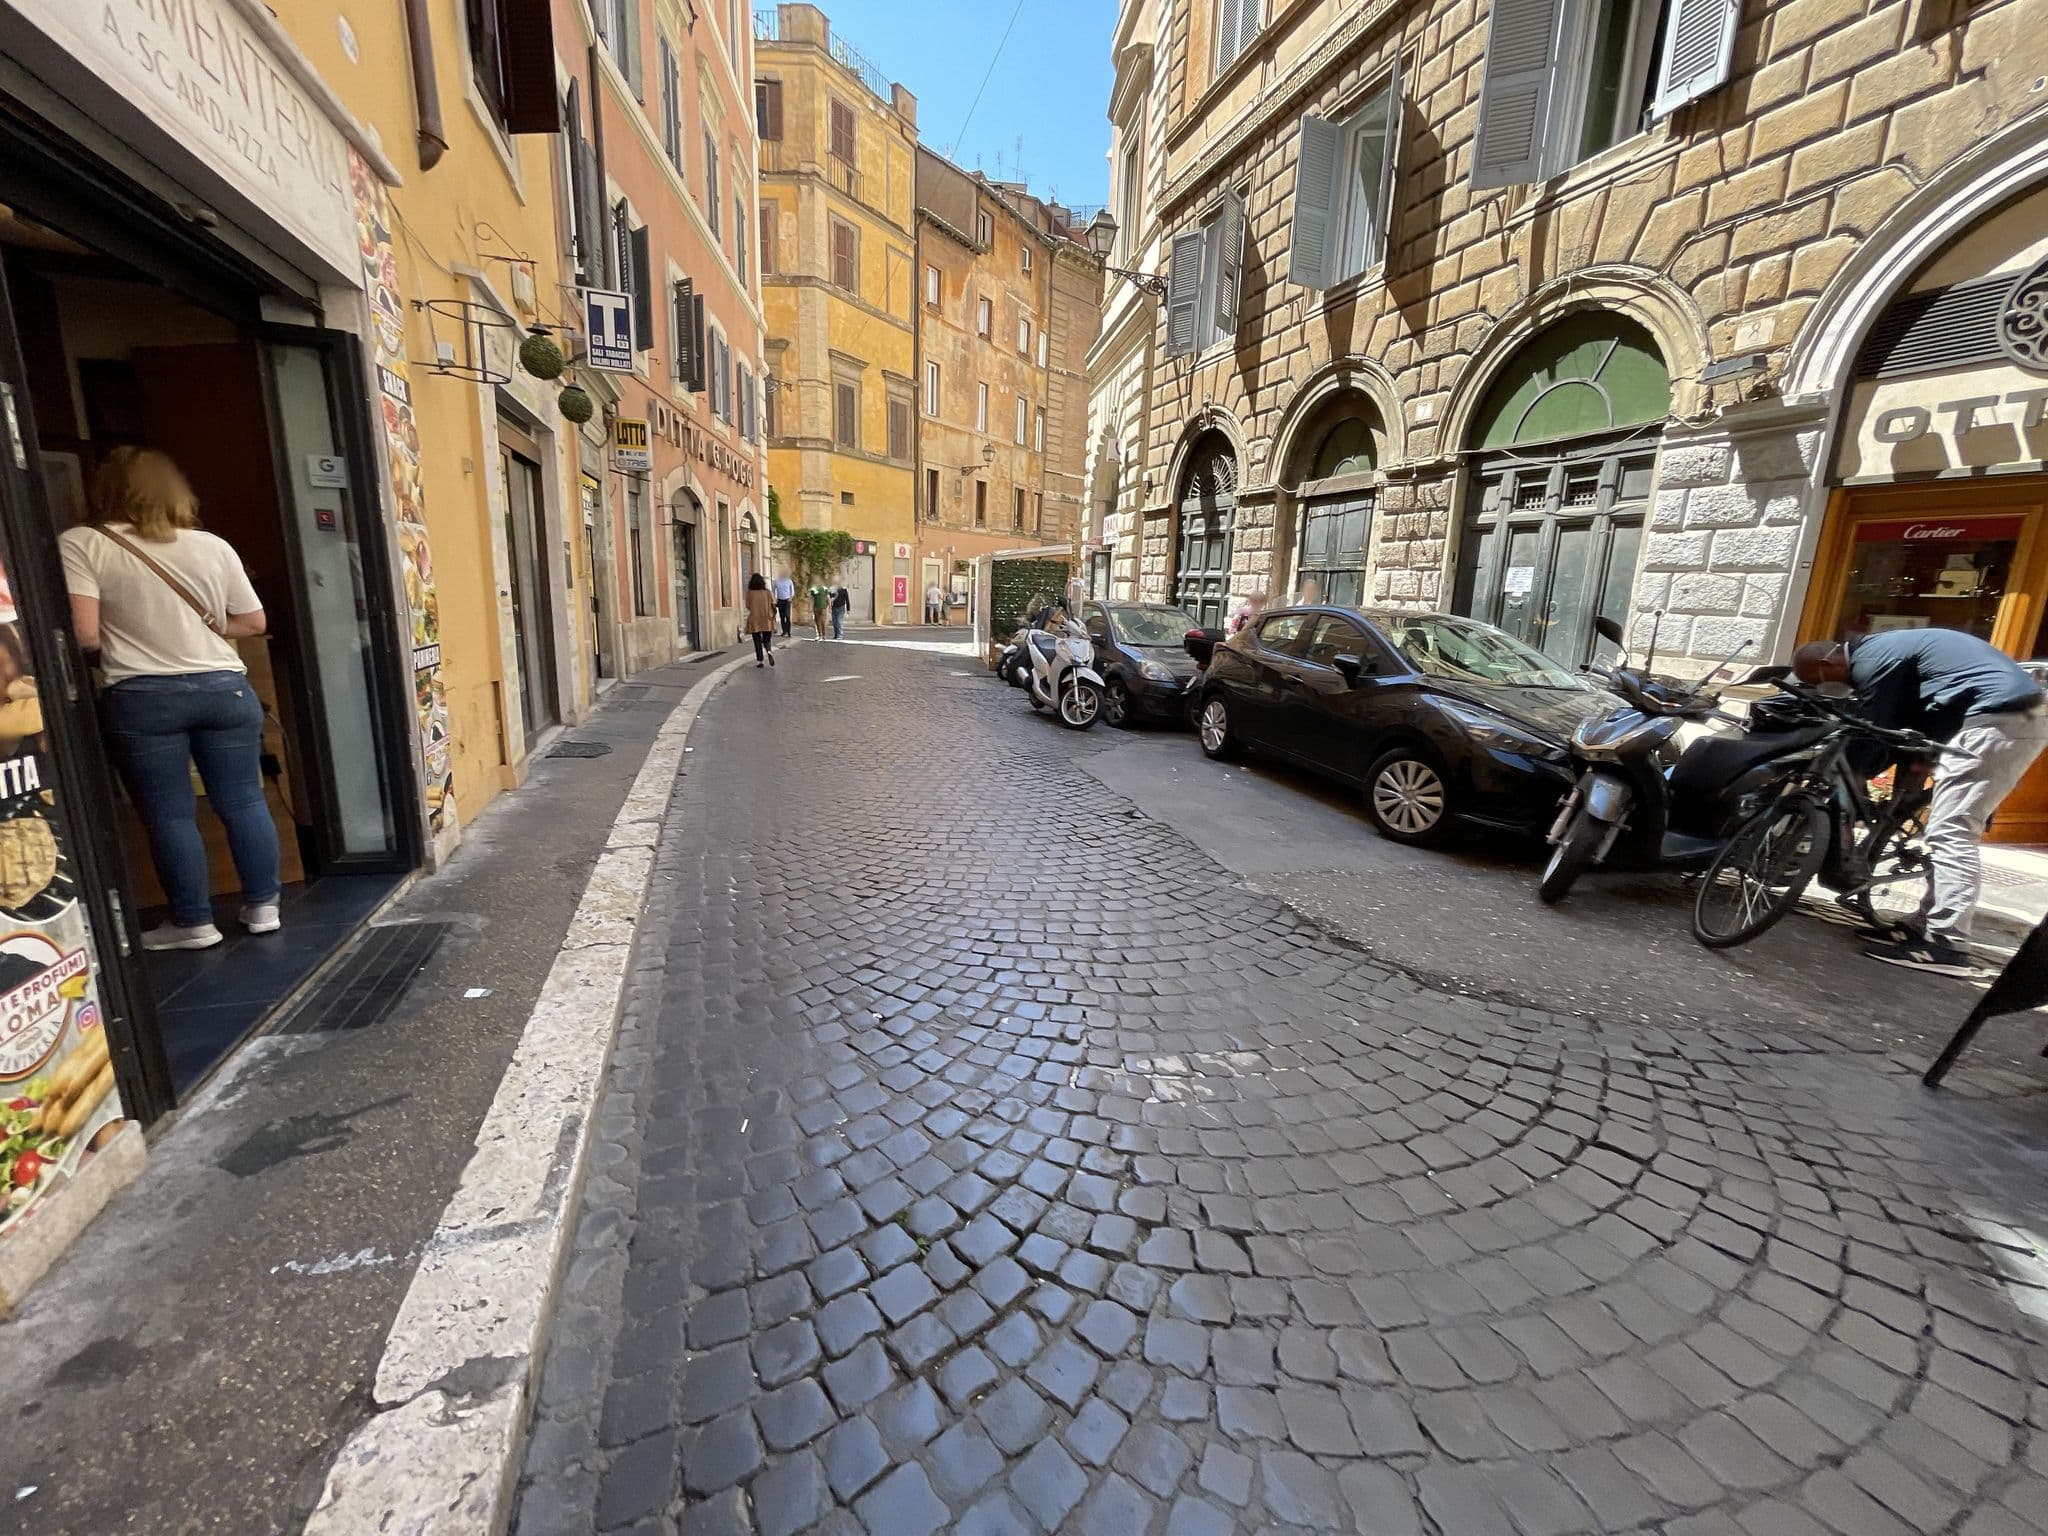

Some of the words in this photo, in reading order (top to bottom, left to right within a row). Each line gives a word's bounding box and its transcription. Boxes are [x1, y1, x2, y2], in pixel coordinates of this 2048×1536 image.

[137, 31, 281, 188] SCARDAZZA
[590, 293, 626, 347] T
[616, 421, 647, 447] LOTTO
[650, 400, 705, 462] DITTA
[1903, 523, 1966, 539] Cartier
[23, 954, 84, 1001] PROFUMI
